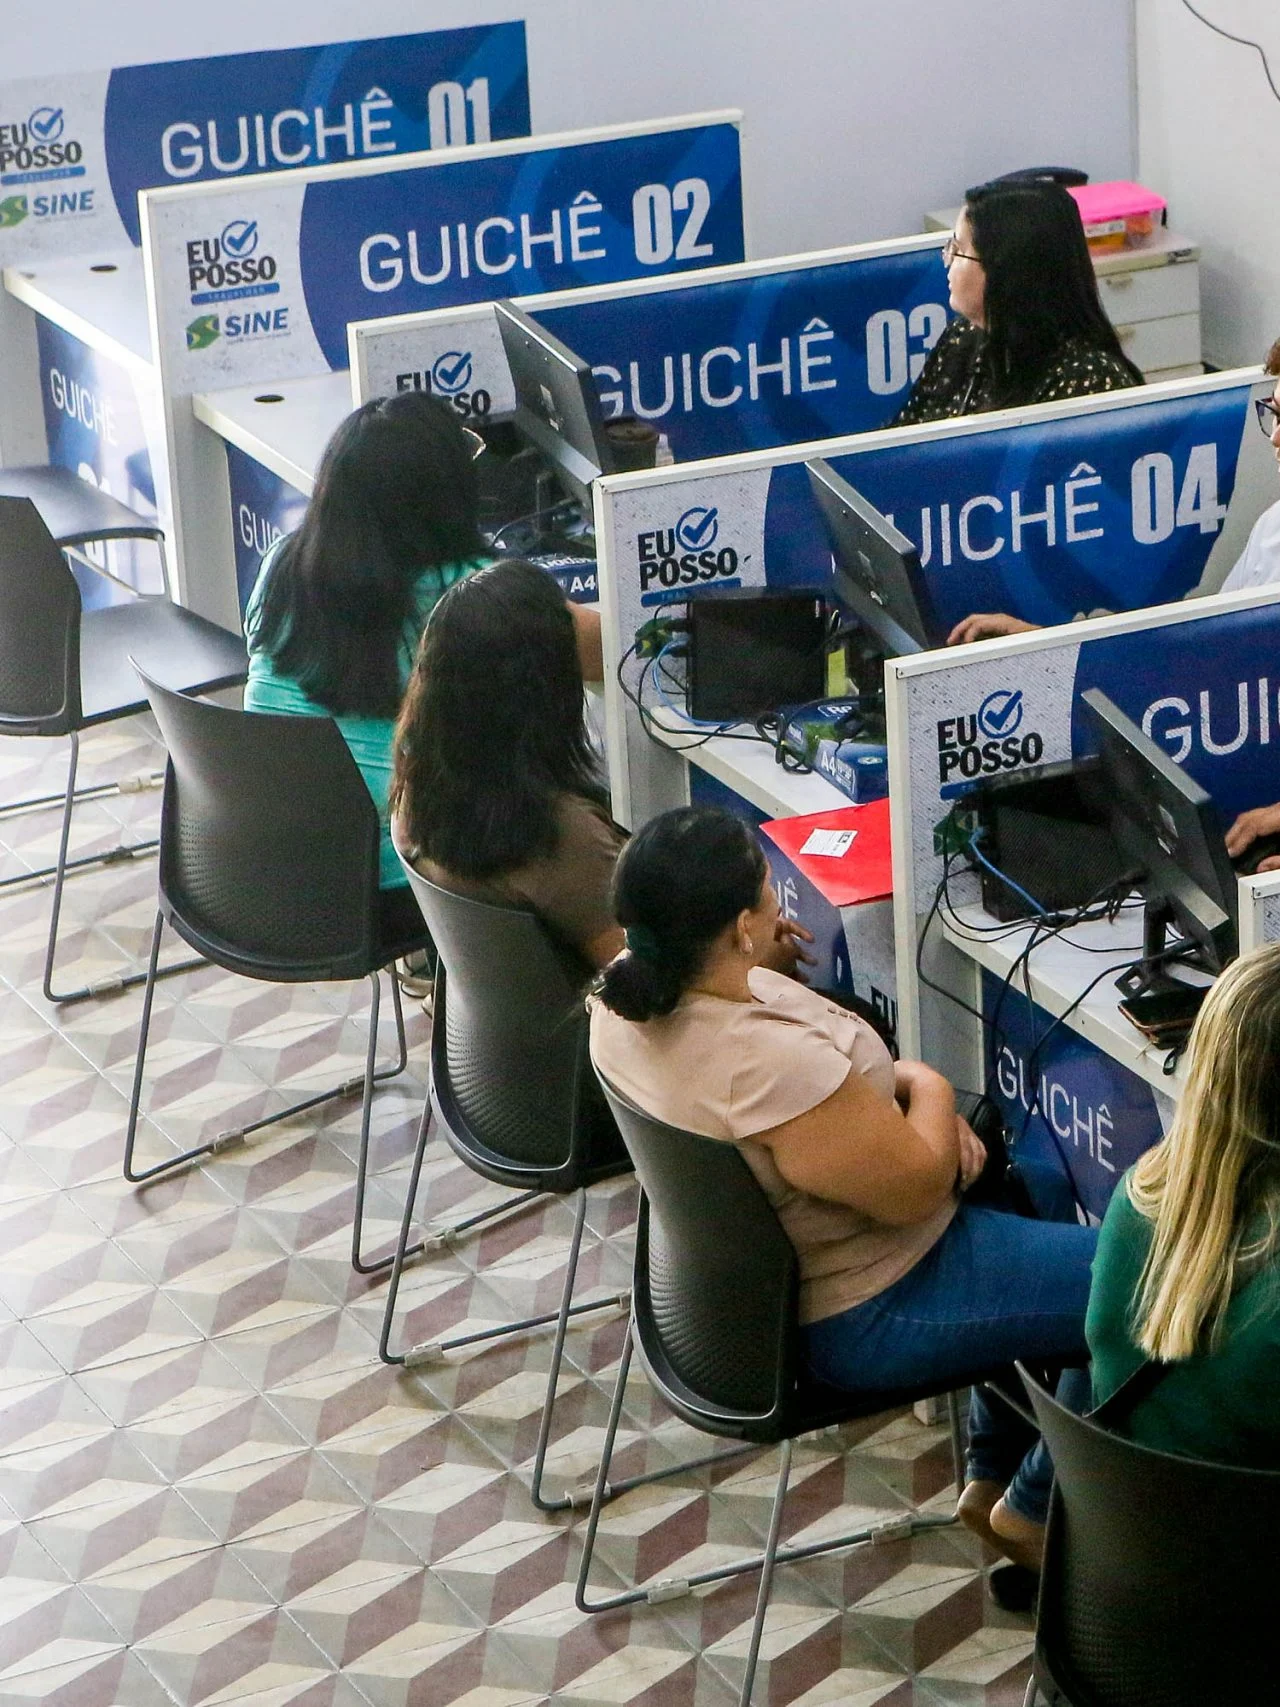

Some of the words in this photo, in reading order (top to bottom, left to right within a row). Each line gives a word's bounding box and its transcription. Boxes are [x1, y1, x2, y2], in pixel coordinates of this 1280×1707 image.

[0, 125, 28, 148] EU
[161, 86, 397, 178] GUICHÊ
[428, 78, 491, 150] 01
[0, 141, 83, 171] POSSO
[33, 190, 95, 217] SINE
[186, 238, 221, 266] EU
[359, 190, 606, 293] GUICHÊ
[632, 178, 714, 265] 02
[189, 255, 277, 291] POSSO
[225, 307, 289, 337] SINE
[592, 317, 837, 419] GUICHÊ
[866, 302, 948, 396] 03
[884, 461, 1104, 568] UICHÊ
[1131, 443, 1227, 545] 04
[637, 528, 676, 563] EU
[570, 574, 596, 593] A4
[639, 547, 738, 592] POSSO
[937, 714, 978, 751] EU
[821, 750, 837, 777] A4
[940, 732, 1043, 783] POSSO
[997, 1045, 1116, 1173] GUICHÊ
